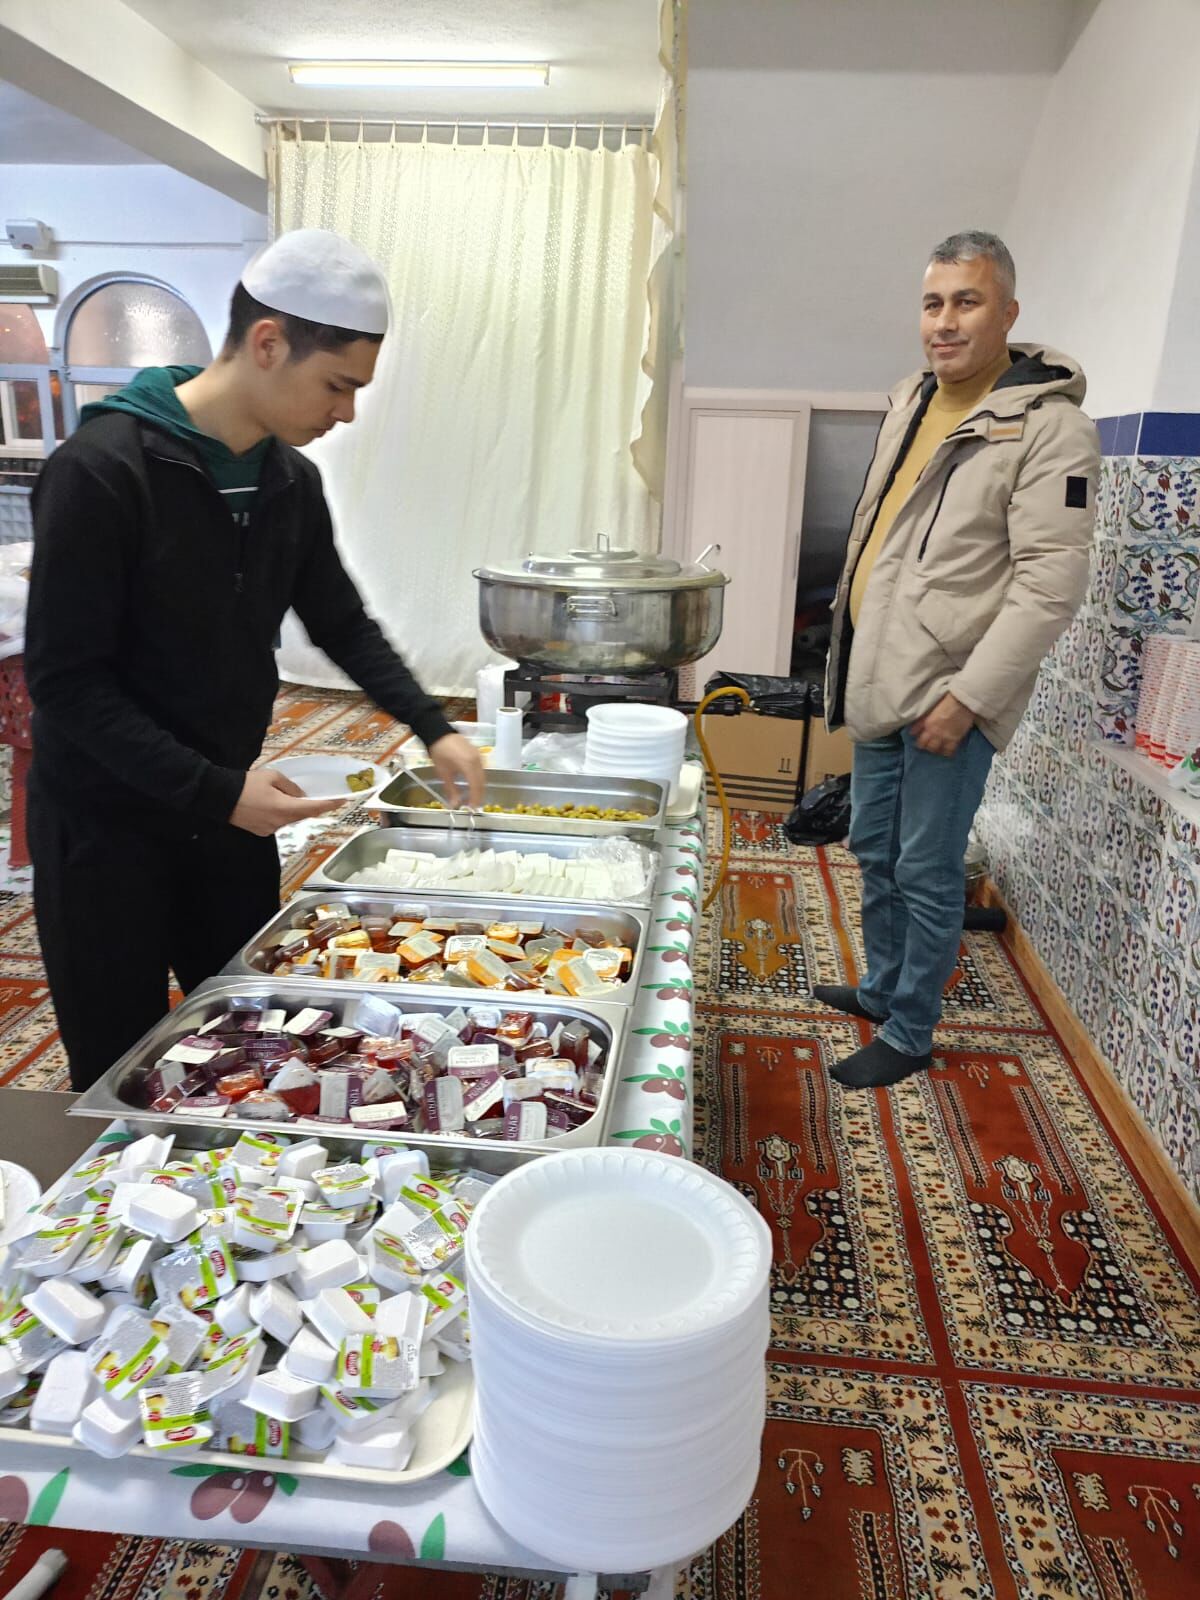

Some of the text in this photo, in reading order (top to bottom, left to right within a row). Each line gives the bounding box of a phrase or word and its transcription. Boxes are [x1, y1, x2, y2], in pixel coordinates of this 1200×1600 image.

[350, 1088, 360, 1106] TUN
[427, 1092, 437, 1119] TUNAS
[508, 1115, 519, 1139] UNAS
